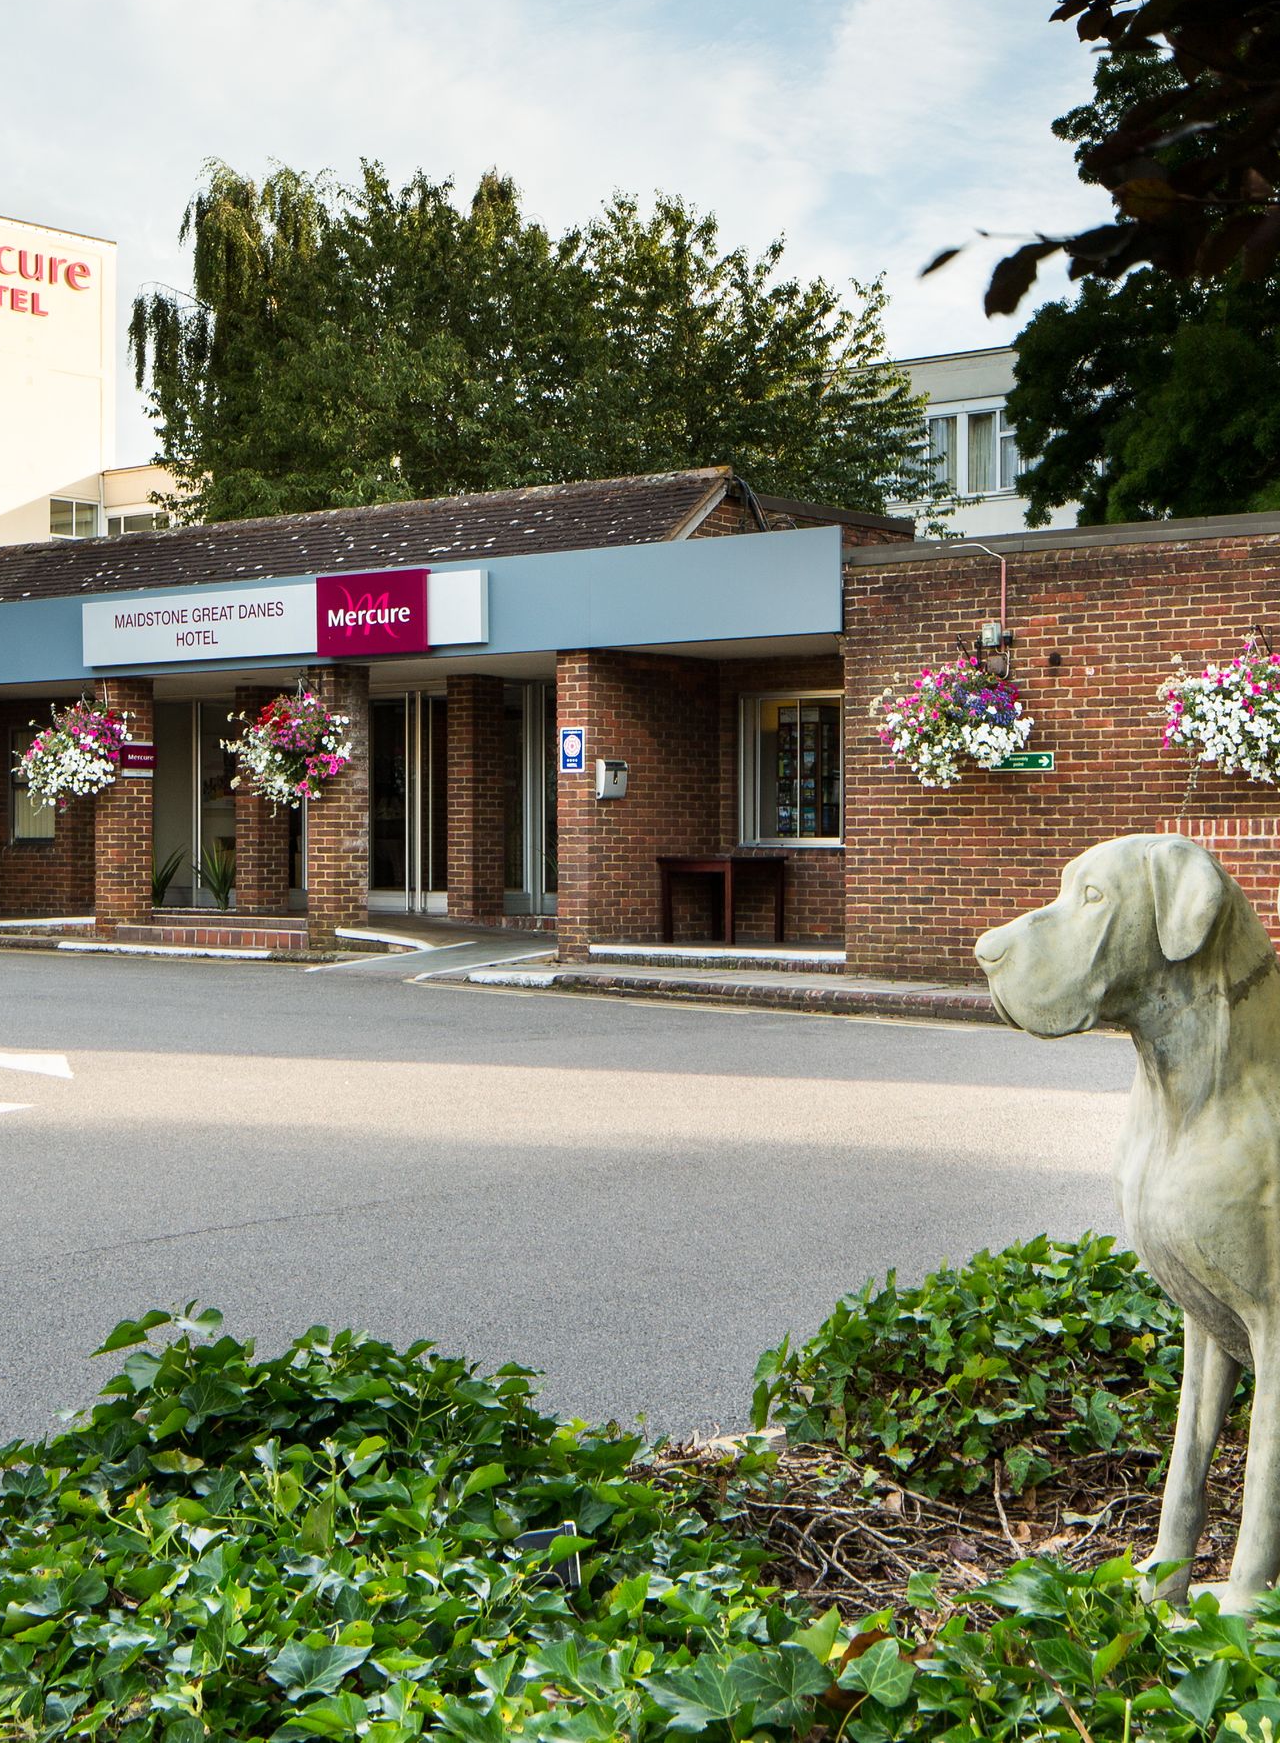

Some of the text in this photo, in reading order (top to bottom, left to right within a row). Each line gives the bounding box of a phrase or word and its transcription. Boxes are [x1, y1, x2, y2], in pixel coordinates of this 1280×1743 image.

[114, 601, 284, 629] MAIDSTONE GREAT DANES
[327, 606, 411, 628] Mercure
[176, 630, 219, 647] HOTEL
[127, 753, 155, 761] Mercure
